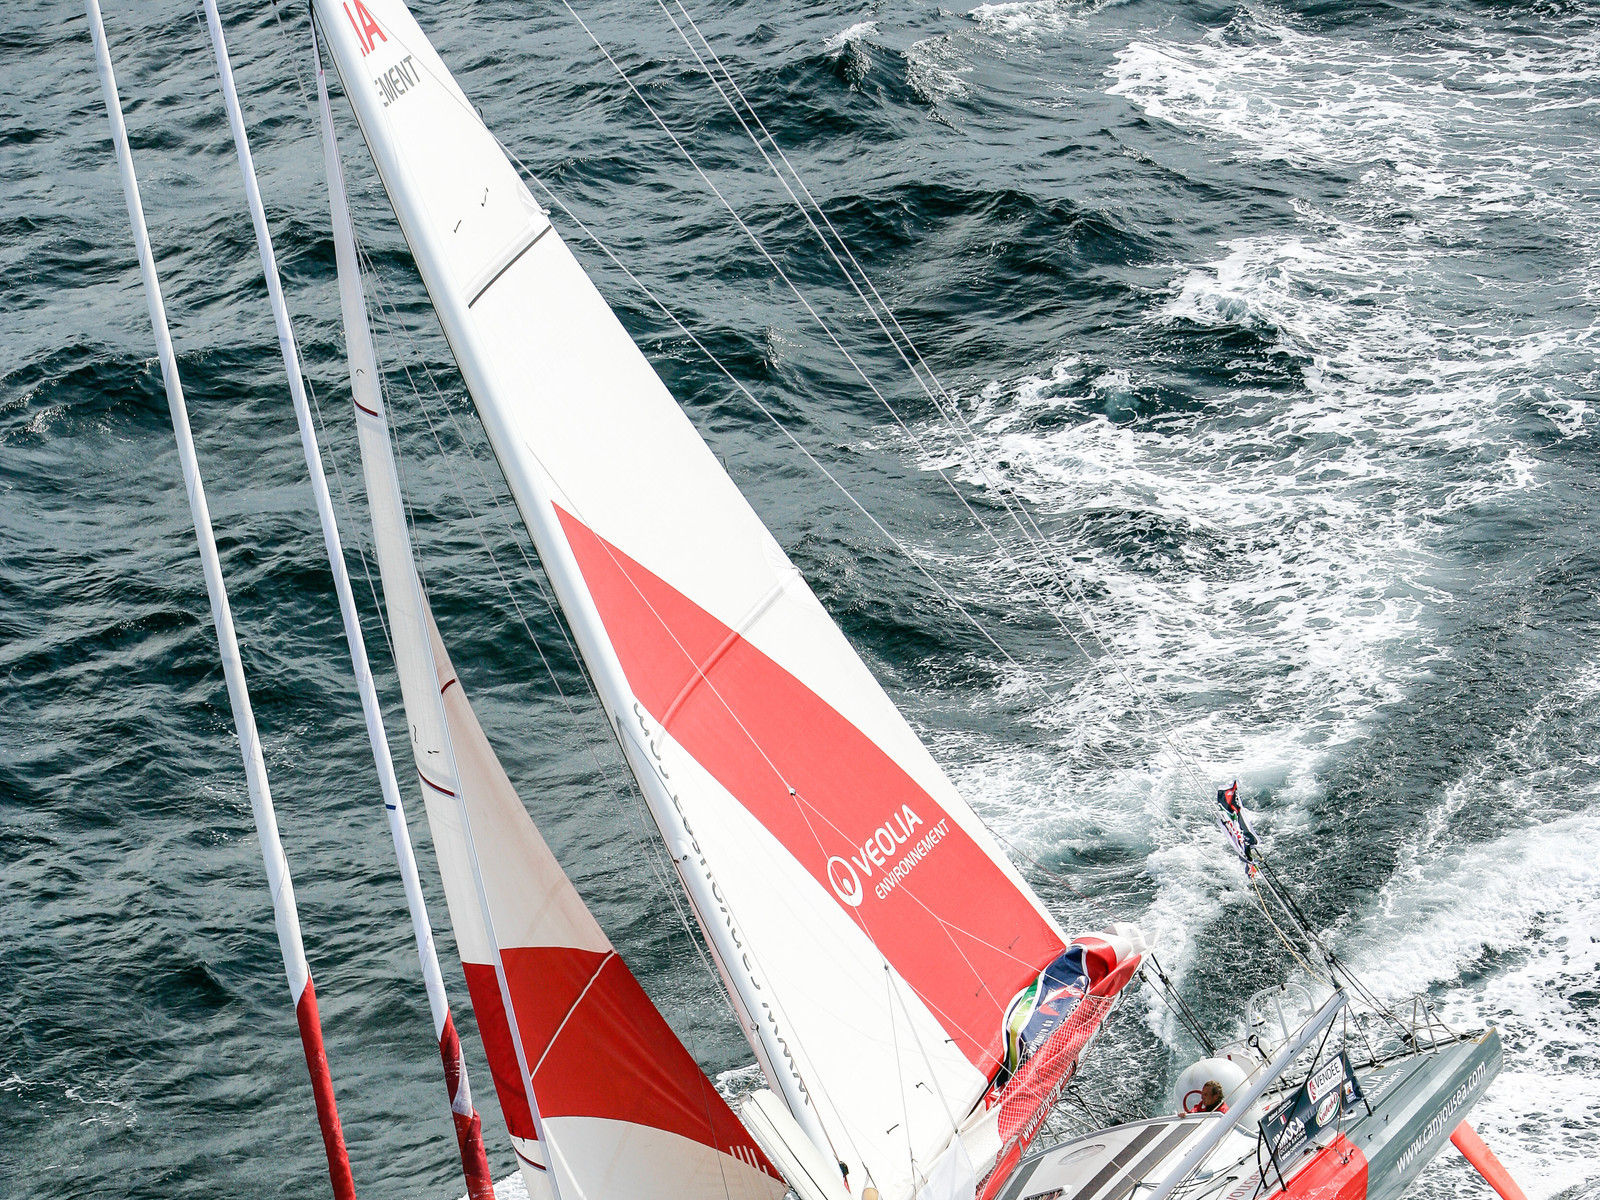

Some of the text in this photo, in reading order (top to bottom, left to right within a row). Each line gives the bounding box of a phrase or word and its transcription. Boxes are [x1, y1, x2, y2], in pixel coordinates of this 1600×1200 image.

[343, 0, 388, 57] IA
[851, 803, 923, 877] VEOLIA
[875, 818, 950, 900] ENVIRONNEMENT
[1397, 1061, 1487, 1174] www.canyousea.com
